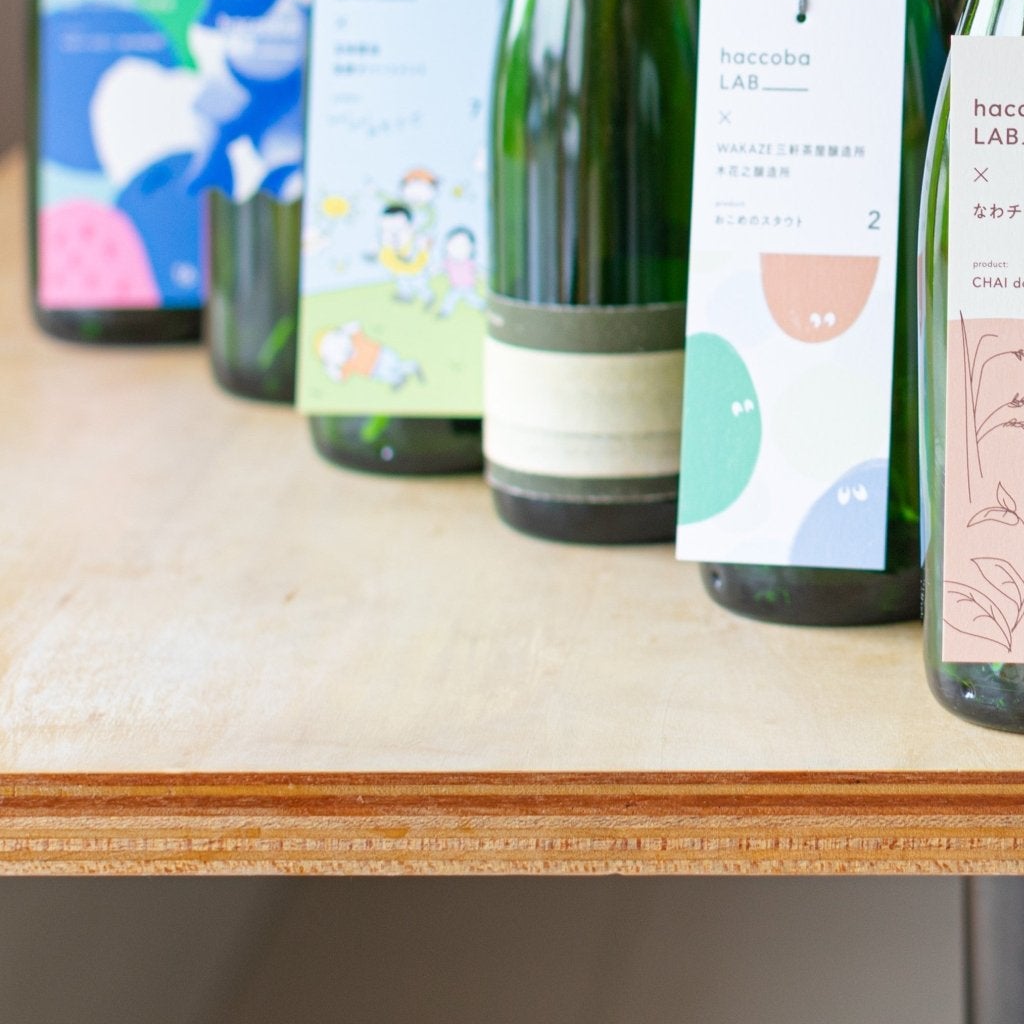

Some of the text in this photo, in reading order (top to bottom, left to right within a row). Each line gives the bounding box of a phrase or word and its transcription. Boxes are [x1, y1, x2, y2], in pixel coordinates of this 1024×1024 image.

[720, 47, 811, 66] haccoba
[867, 210, 881, 230] 2
[972, 260, 1009, 269] product:
[972, 277, 1008, 289] CHAI
